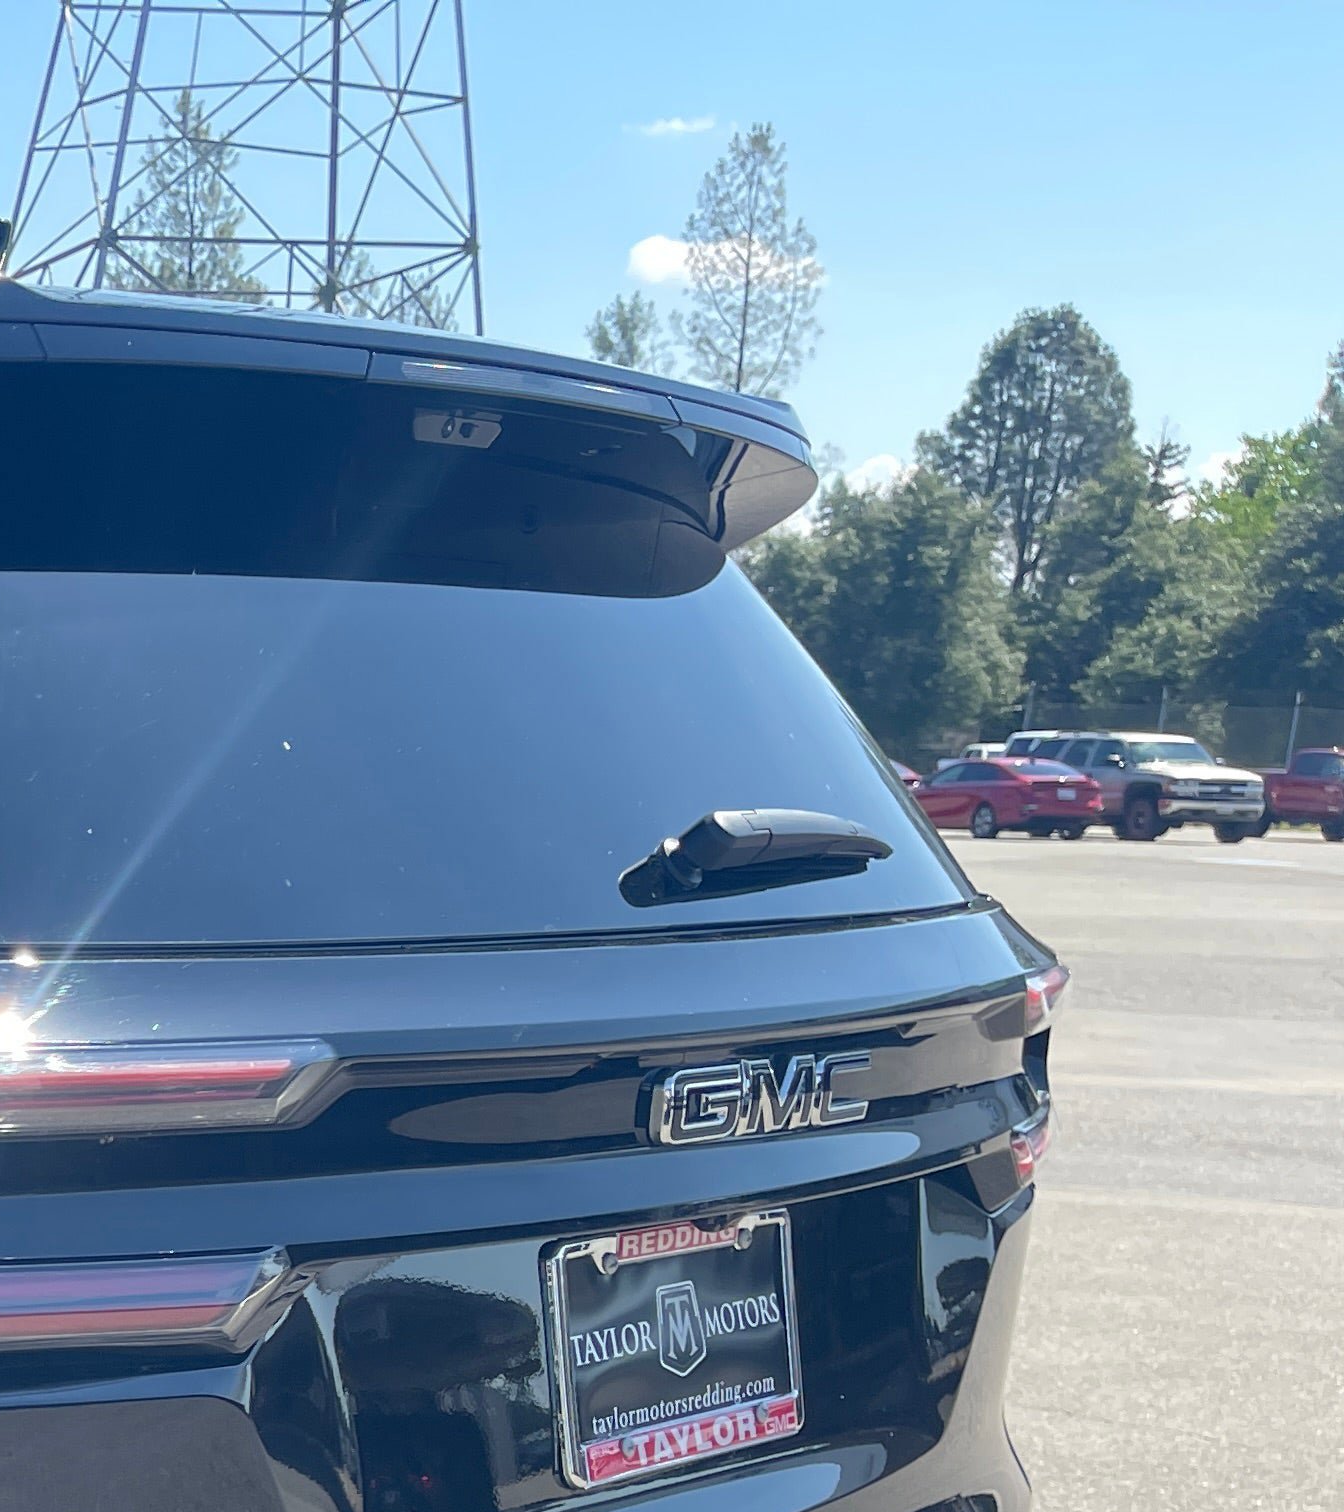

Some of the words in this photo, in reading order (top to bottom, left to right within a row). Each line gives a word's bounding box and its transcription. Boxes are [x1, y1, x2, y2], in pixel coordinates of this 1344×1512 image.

[656, 1049, 873, 1145] GMC
[621, 1225, 735, 1258] REDDING
[570, 1320, 656, 1367] TAYLOR
[705, 1292, 780, 1338] MOTORS
[592, 1376, 776, 1436] taylormotorsredding.com
[632, 1409, 757, 1466] TAYLOR
[764, 1411, 797, 1436] GMC
